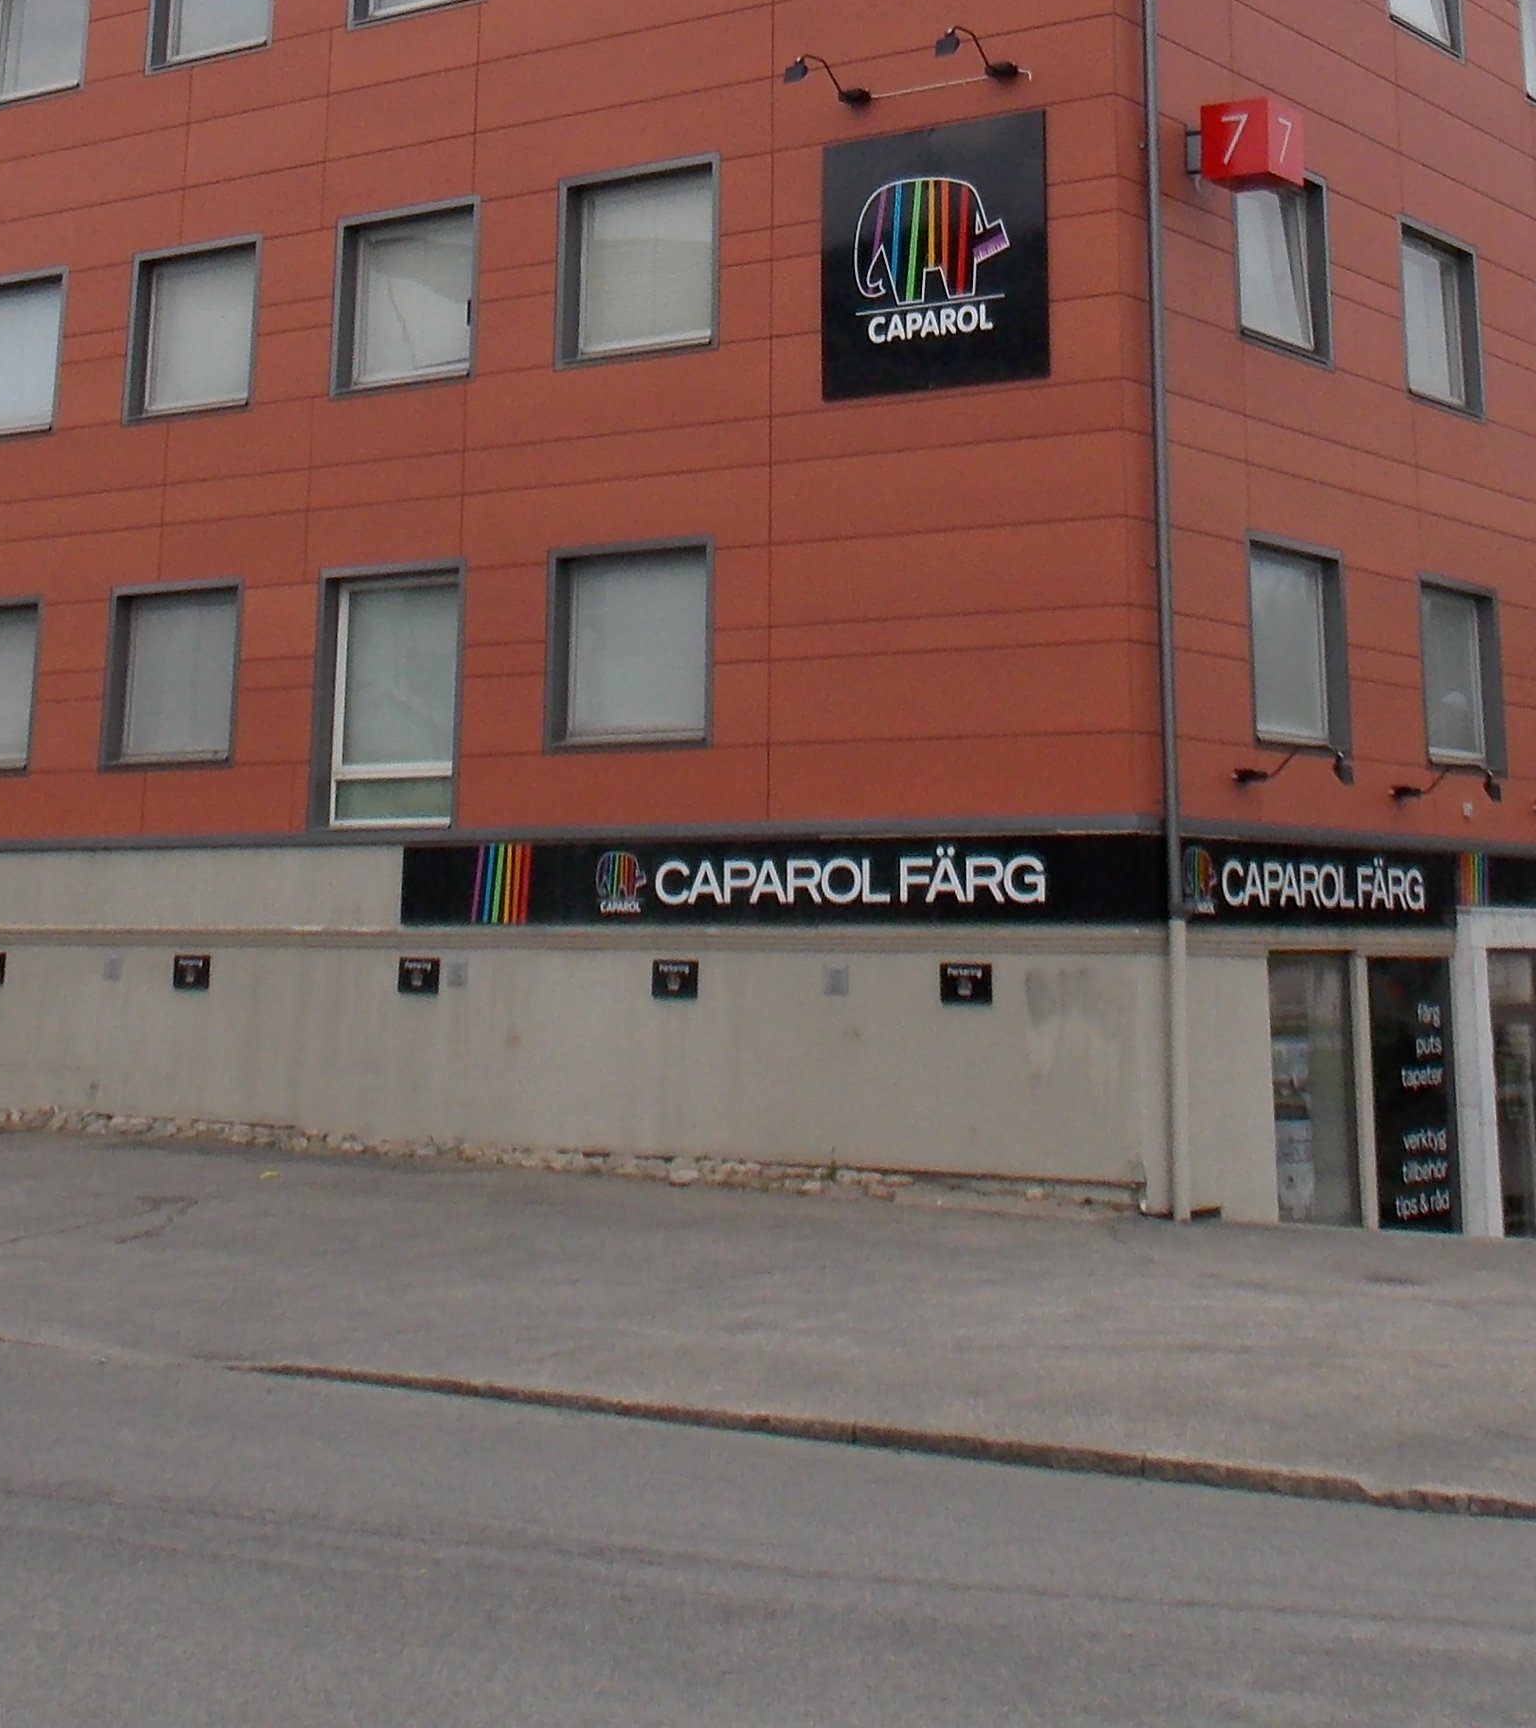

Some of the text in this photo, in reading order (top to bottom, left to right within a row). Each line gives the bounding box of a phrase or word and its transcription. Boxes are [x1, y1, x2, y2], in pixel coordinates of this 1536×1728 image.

[1221, 113, 1248, 165] 7
[1278, 116, 1292, 164] 7
[868, 303, 994, 344] CAPAROL
[655, 845, 1046, 905] CAPAROL FÄRG
[1221, 857, 1426, 912] CAPAROL FÄRG
[600, 900, 642, 914] CAPAROL
[1417, 1002, 1441, 1027] färg
[1415, 1035, 1443, 1058] puts
[1401, 1066, 1444, 1090] tapeter
[1403, 1127, 1448, 1152] verktyg
[1402, 1159, 1448, 1184] tillbehör
[1395, 1188, 1450, 1220] tips & råd
